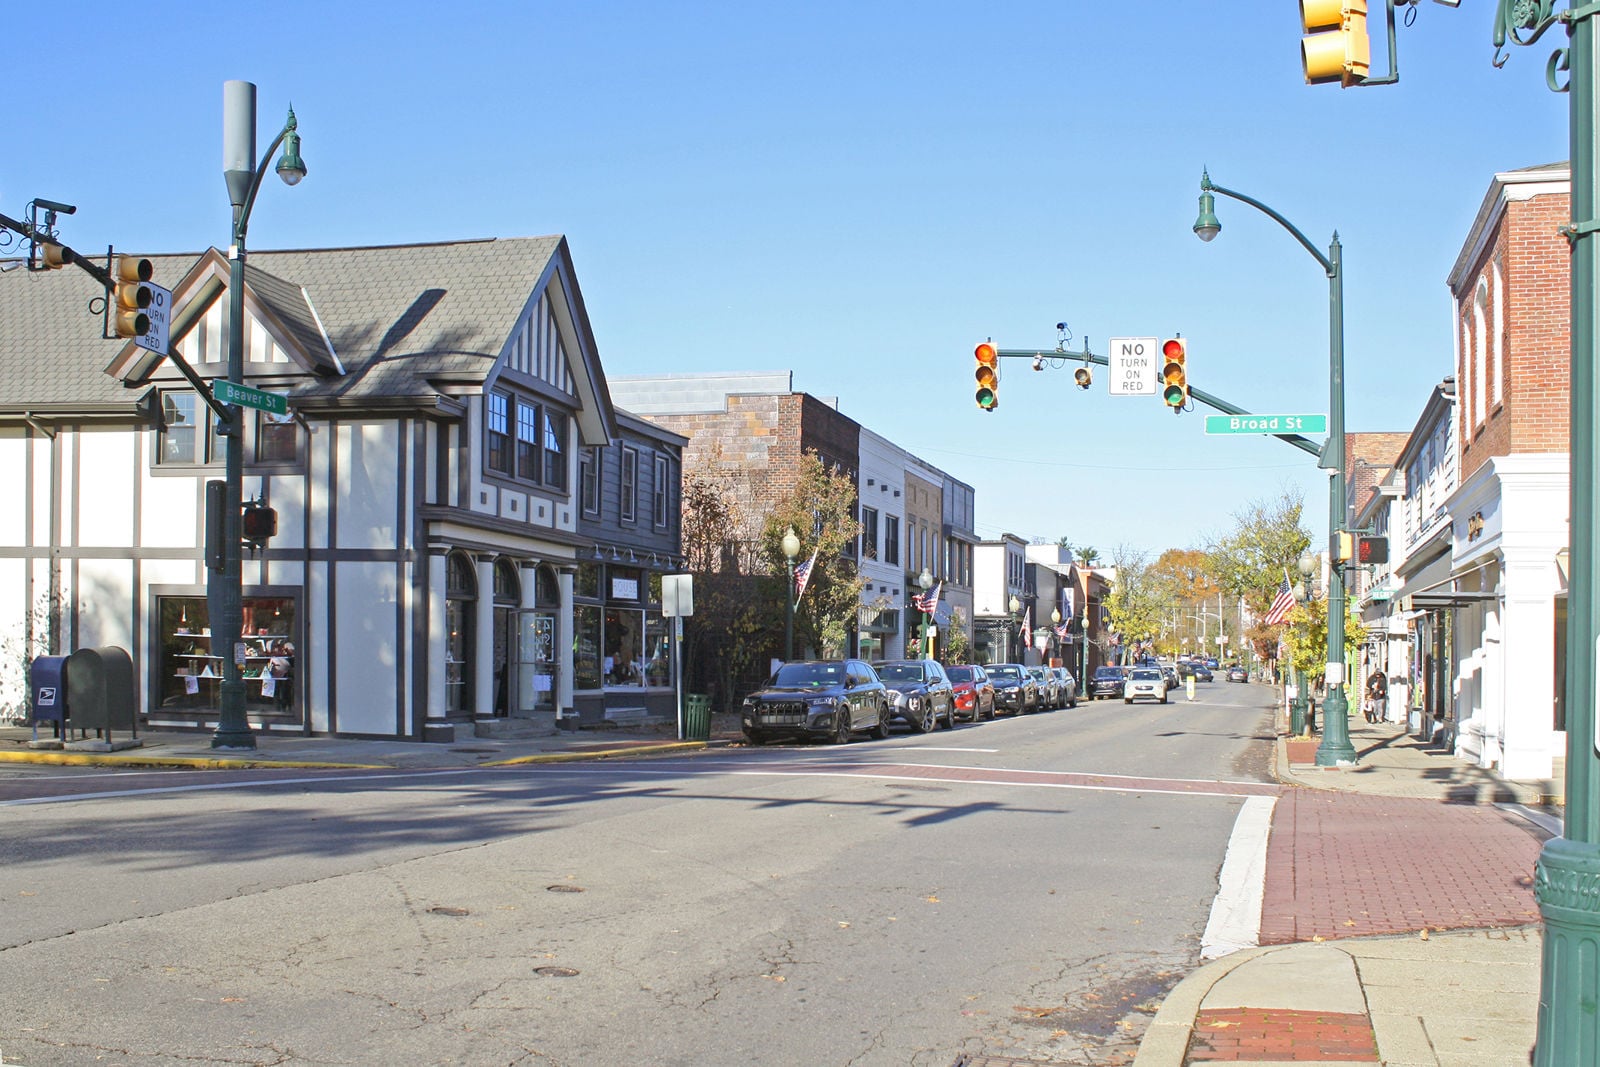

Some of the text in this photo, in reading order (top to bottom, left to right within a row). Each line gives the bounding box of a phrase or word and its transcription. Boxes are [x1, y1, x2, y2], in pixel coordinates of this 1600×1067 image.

[145, 335, 160, 349] RED
[1121, 343, 1145, 356] NO
[1120, 358, 1148, 368] TURN
[1126, 370, 1140, 380] ON
[1122, 381, 1144, 391] RED
[227, 385, 276, 408] Beaver St
[1229, 416, 1302, 430] Broad St
